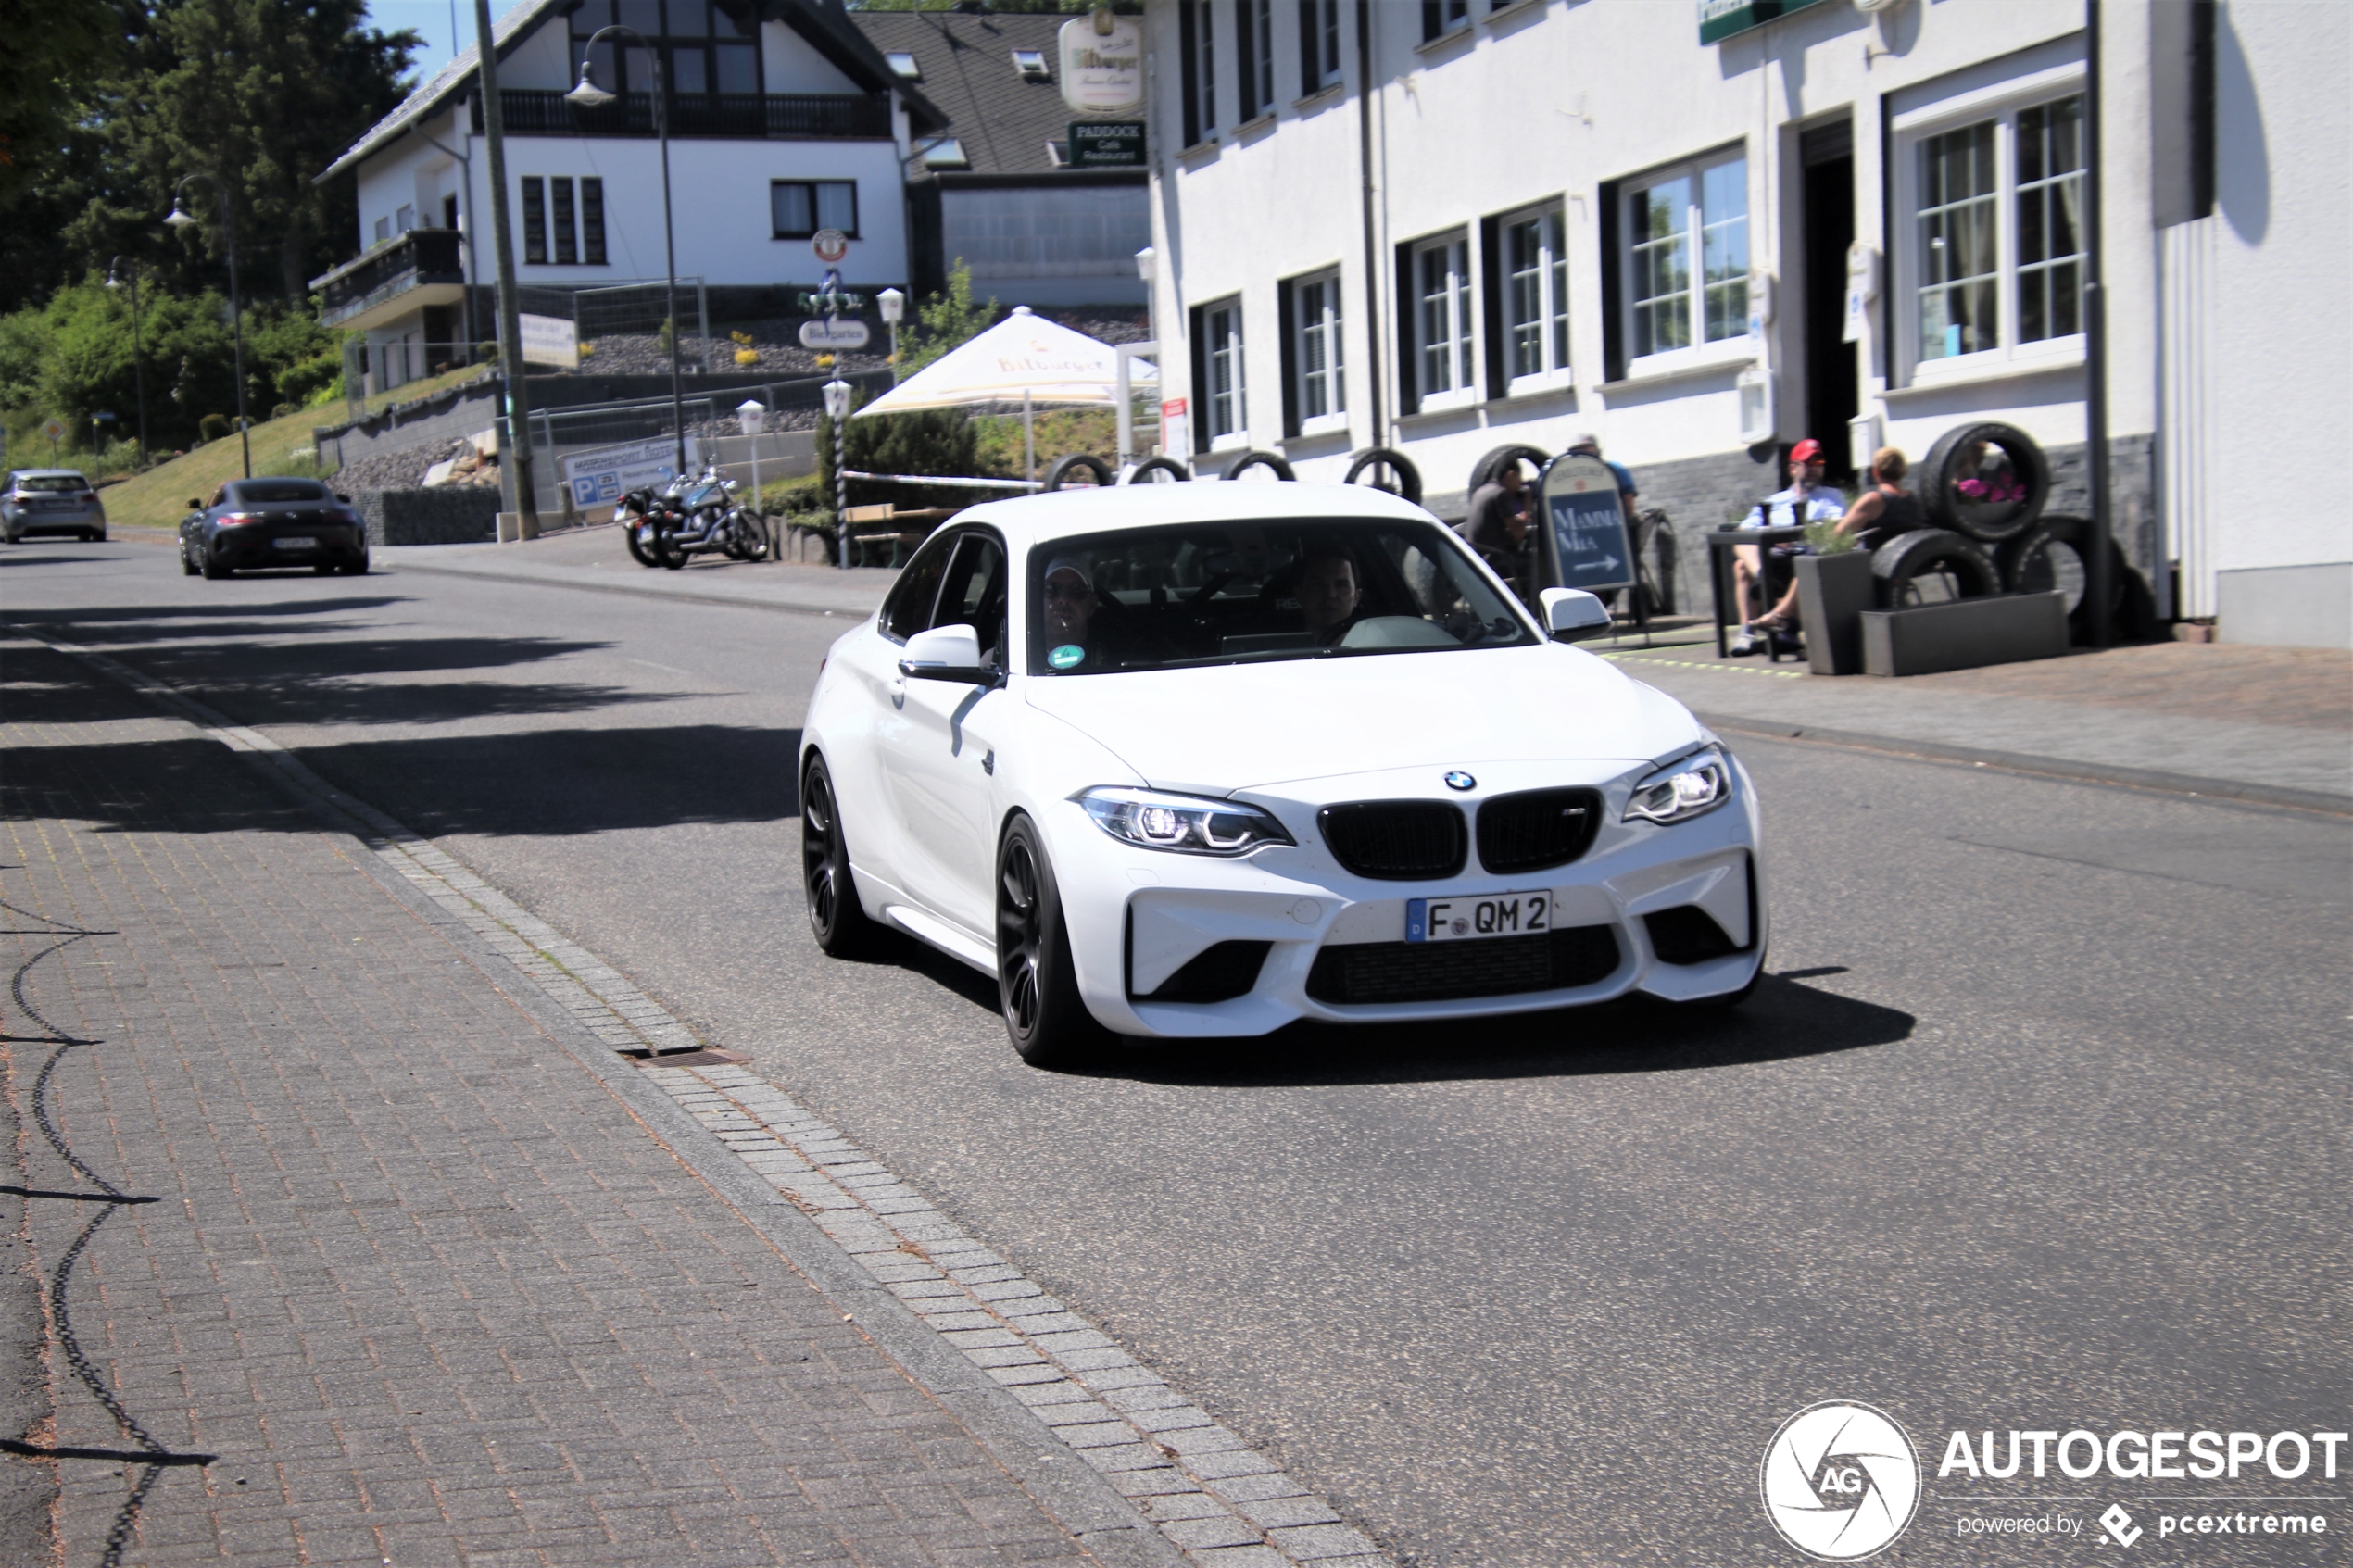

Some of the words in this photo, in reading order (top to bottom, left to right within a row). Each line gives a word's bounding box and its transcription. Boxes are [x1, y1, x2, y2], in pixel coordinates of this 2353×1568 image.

[1076, 125, 1140, 138] PADDOCK
[1082, 150, 1136, 160] Restaurant
[997, 357, 1104, 372] Bitburger
[1428, 904, 1451, 936] F
[1412, 923, 1421, 935] D
